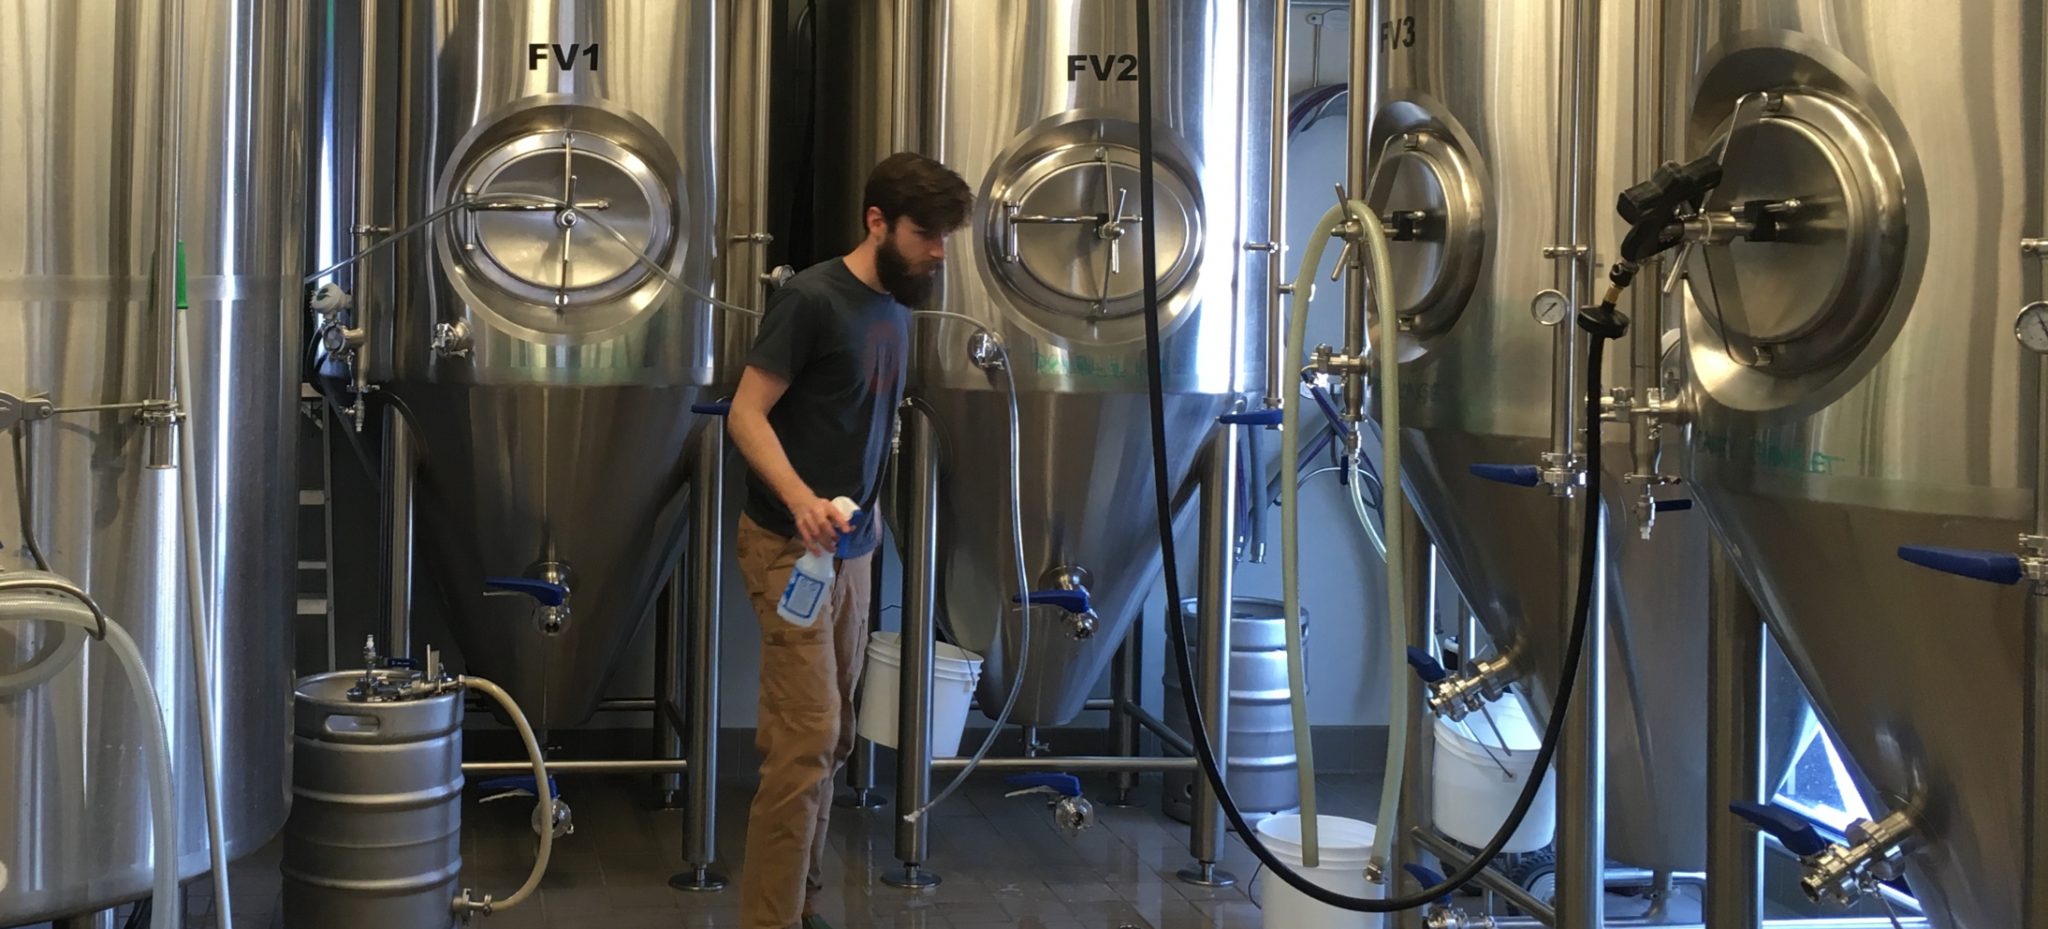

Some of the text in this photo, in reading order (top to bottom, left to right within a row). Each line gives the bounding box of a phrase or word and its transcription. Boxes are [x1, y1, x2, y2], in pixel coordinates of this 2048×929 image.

[1380, 16, 1416, 53] FV3
[529, 43, 599, 71] FV1
[1067, 54, 1138, 82] FV2
